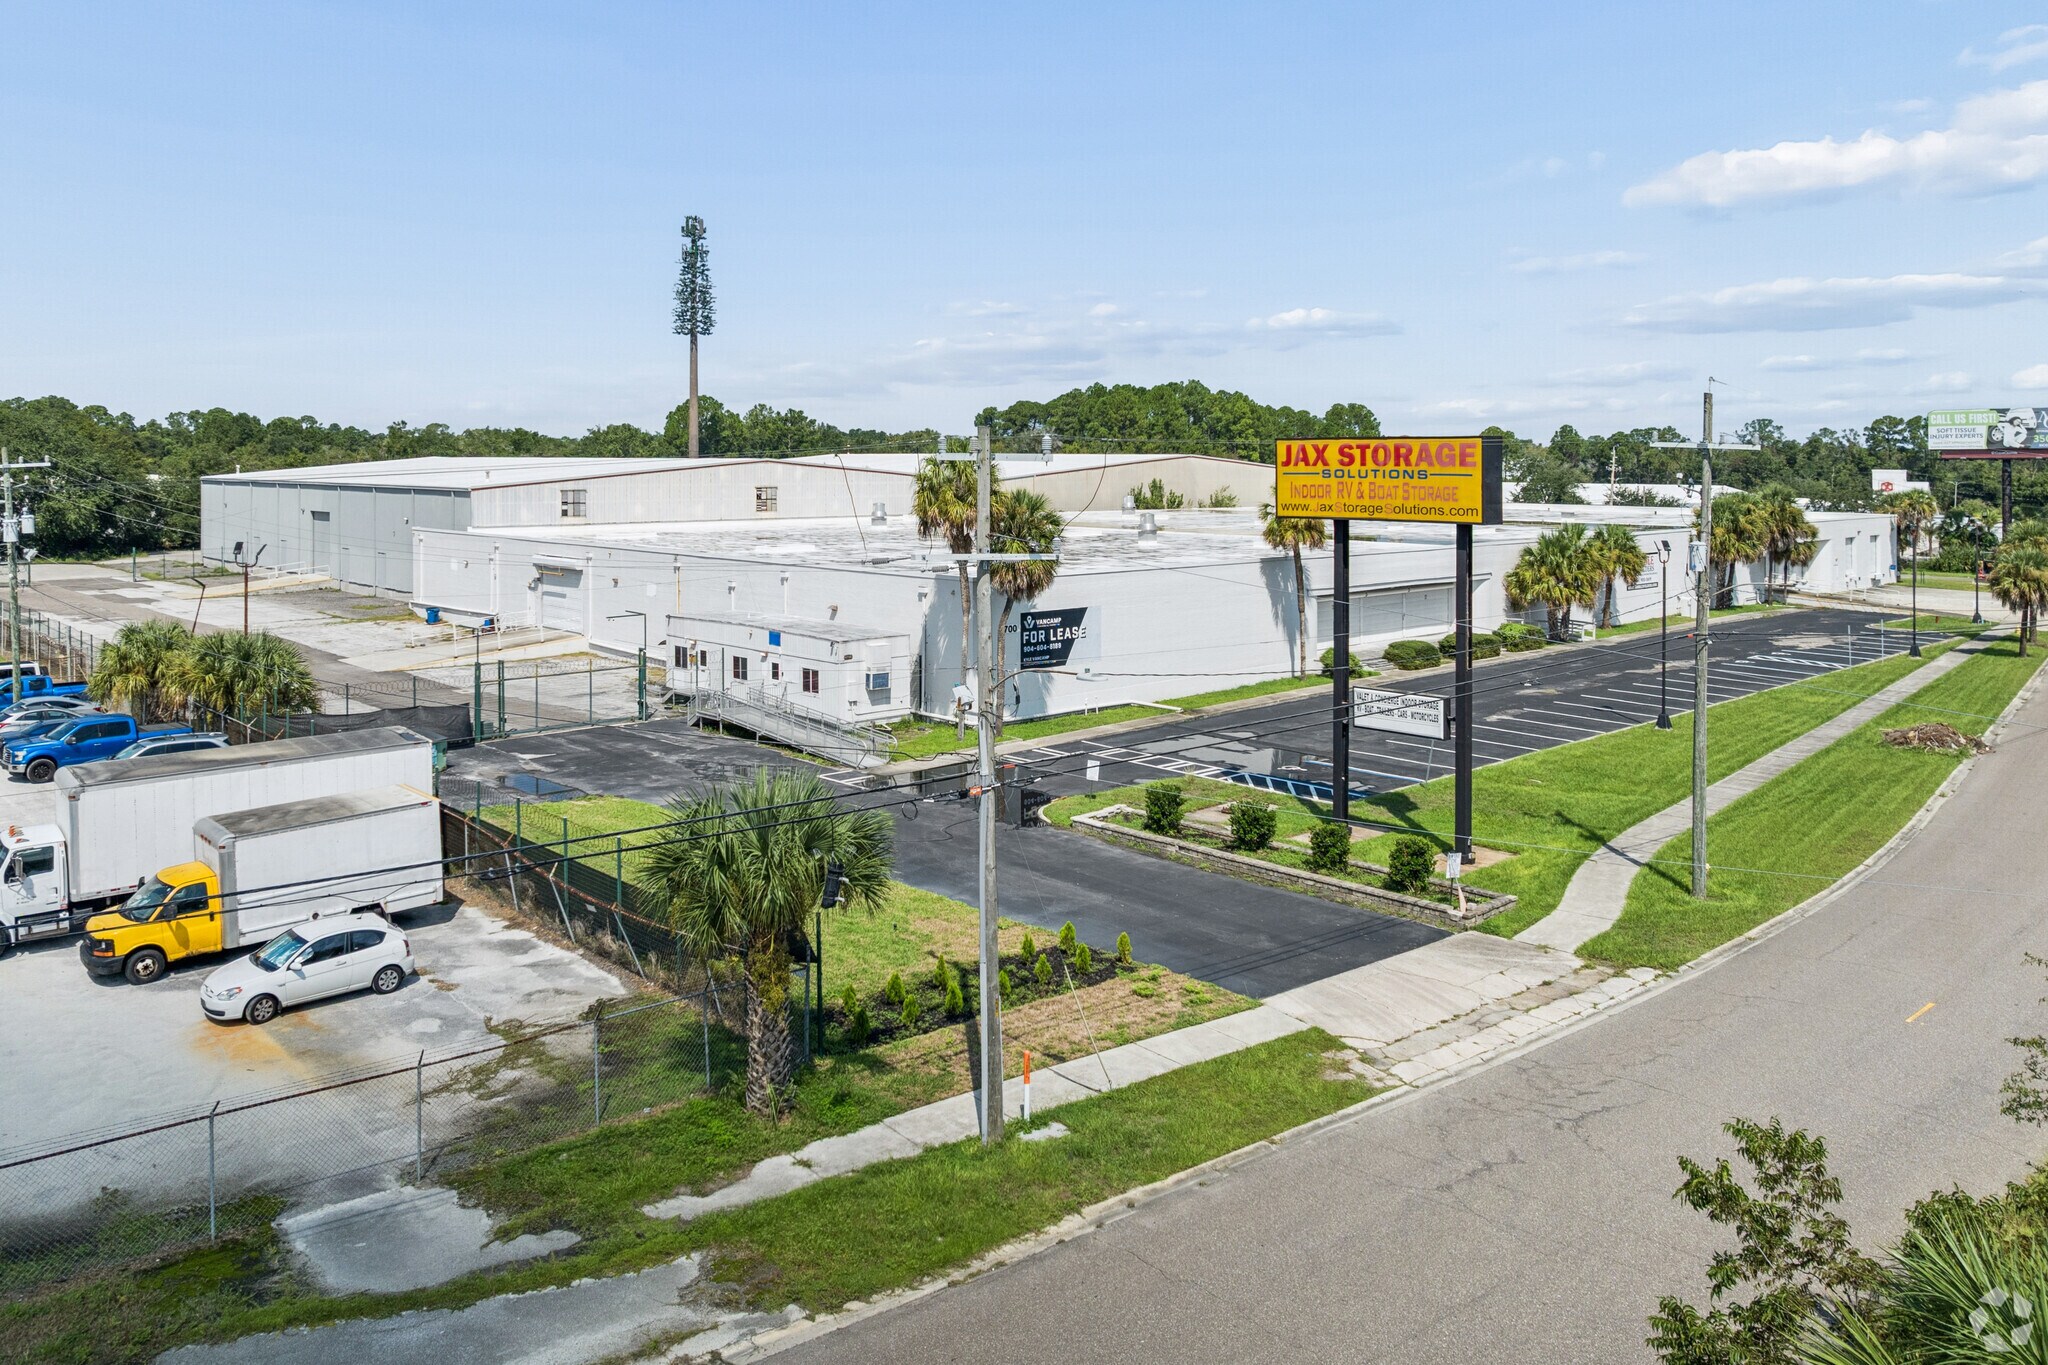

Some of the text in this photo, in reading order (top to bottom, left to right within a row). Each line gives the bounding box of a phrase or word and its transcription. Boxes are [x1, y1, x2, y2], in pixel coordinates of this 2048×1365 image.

[1930, 413, 1997, 424] CALL US FIRST!
[1281, 442, 1477, 467] JAX STORAGE
[1322, 469, 1428, 480] SOLUTIONS
[1290, 482, 1458, 502] INDOOR RV & BOAT STORAGE
[1281, 501, 1479, 517] www.JaxStorageSolutions.com
[1004, 625, 1017, 633] 700
[1023, 626, 1086, 644] FOR LEASE
[1356, 692, 1369, 701] VALET
[1410, 711, 1439, 723] MOTORCYCLES
